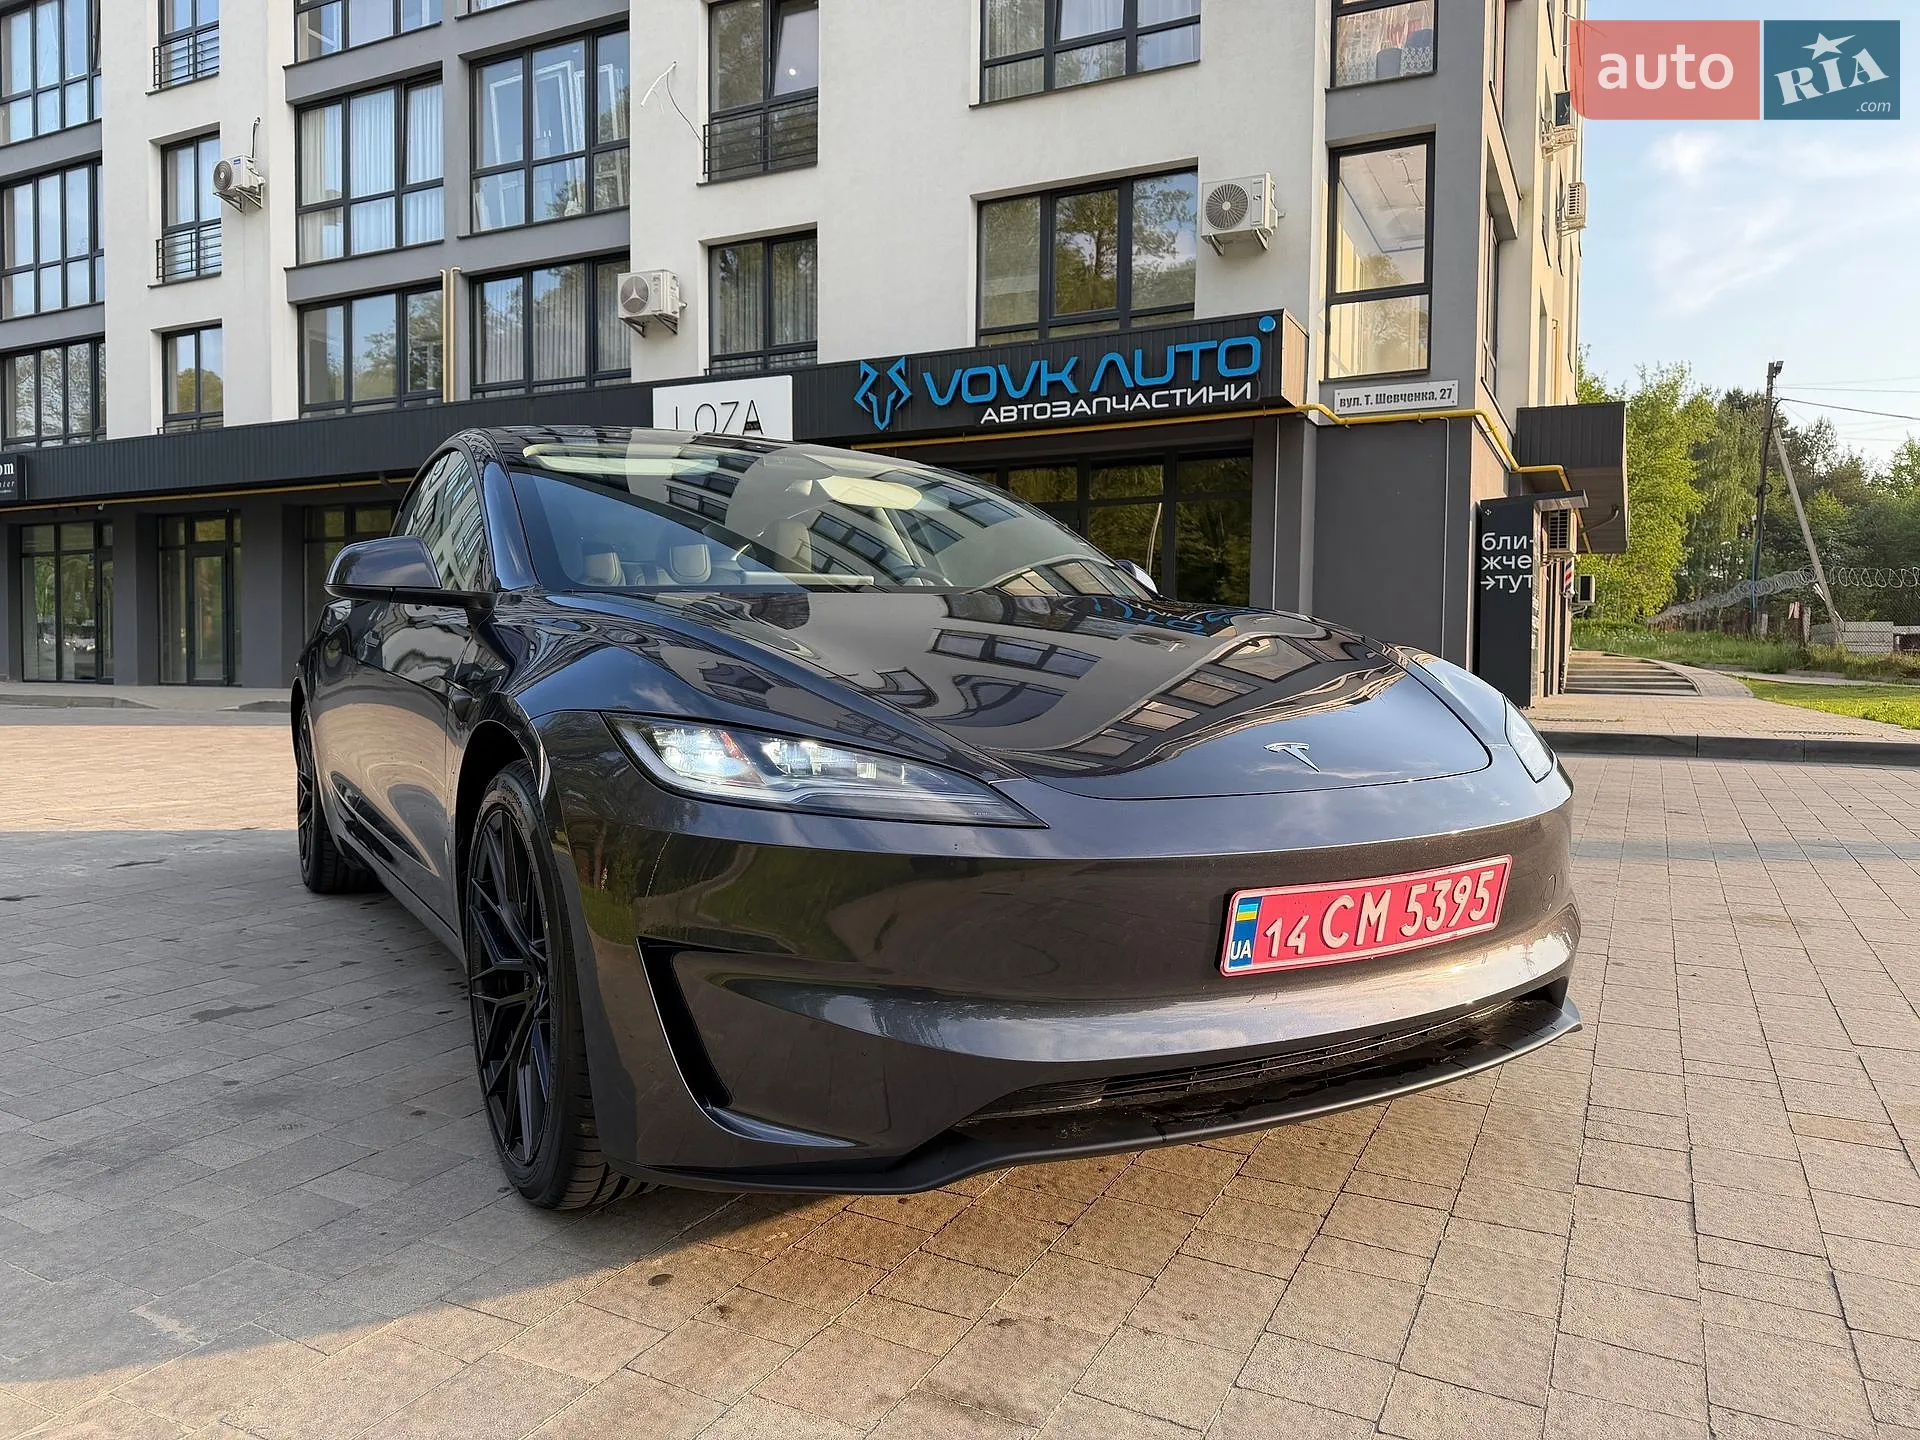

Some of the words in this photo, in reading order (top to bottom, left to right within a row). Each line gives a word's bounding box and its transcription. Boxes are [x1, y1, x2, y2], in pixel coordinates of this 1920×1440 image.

[922, 355, 1080, 407] VOVK
[1090, 335, 1262, 392] AUTO
[980, 382, 1253, 425] АВТОЗАПЧАСТИНИ
[1339, 395, 1362, 408] вул.
[1364, 394, 1373, 406] Т.
[1439, 387, 1453, 400] 27
[1481, 554, 1533, 570] жче
[1494, 574, 1533, 593] тут
[1264, 914, 1310, 958] 14
[1320, 888, 1392, 949] CM
[1399, 870, 1496, 937] 5395
[1229, 939, 1251, 960] UA
